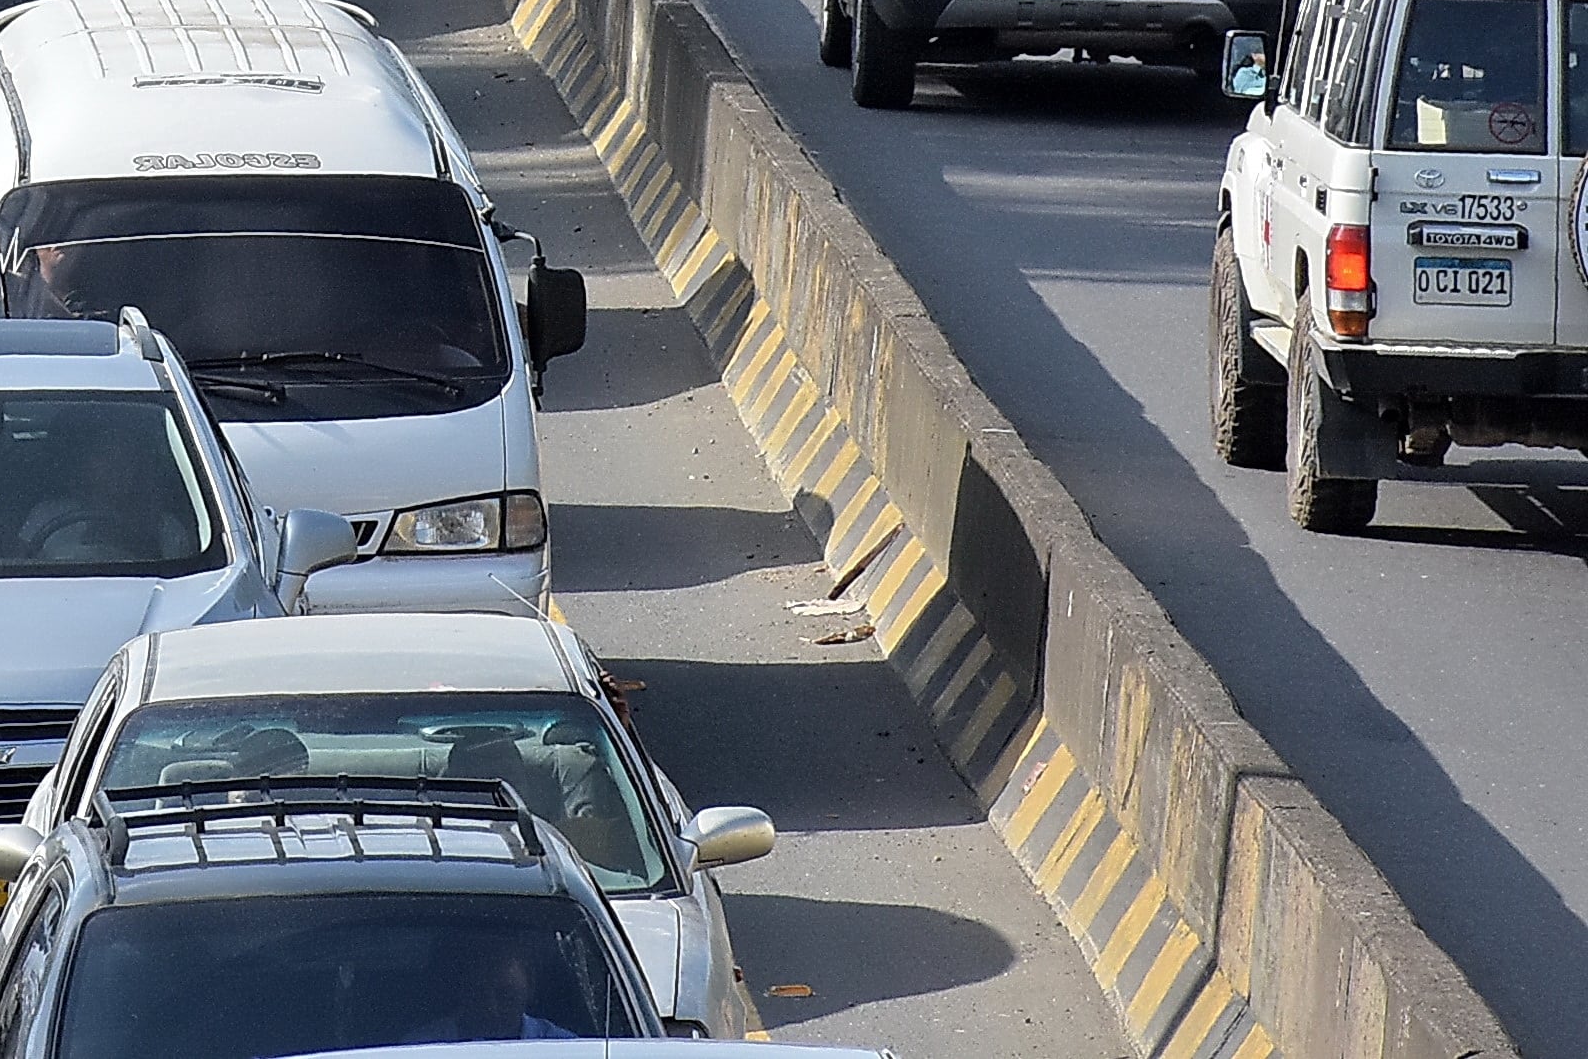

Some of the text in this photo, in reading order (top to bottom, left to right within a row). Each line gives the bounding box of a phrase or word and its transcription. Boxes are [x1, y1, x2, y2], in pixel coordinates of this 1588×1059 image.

[1459, 194, 1516, 221] 17533
[1427, 232, 1516, 247] TOYOTA 4WD
